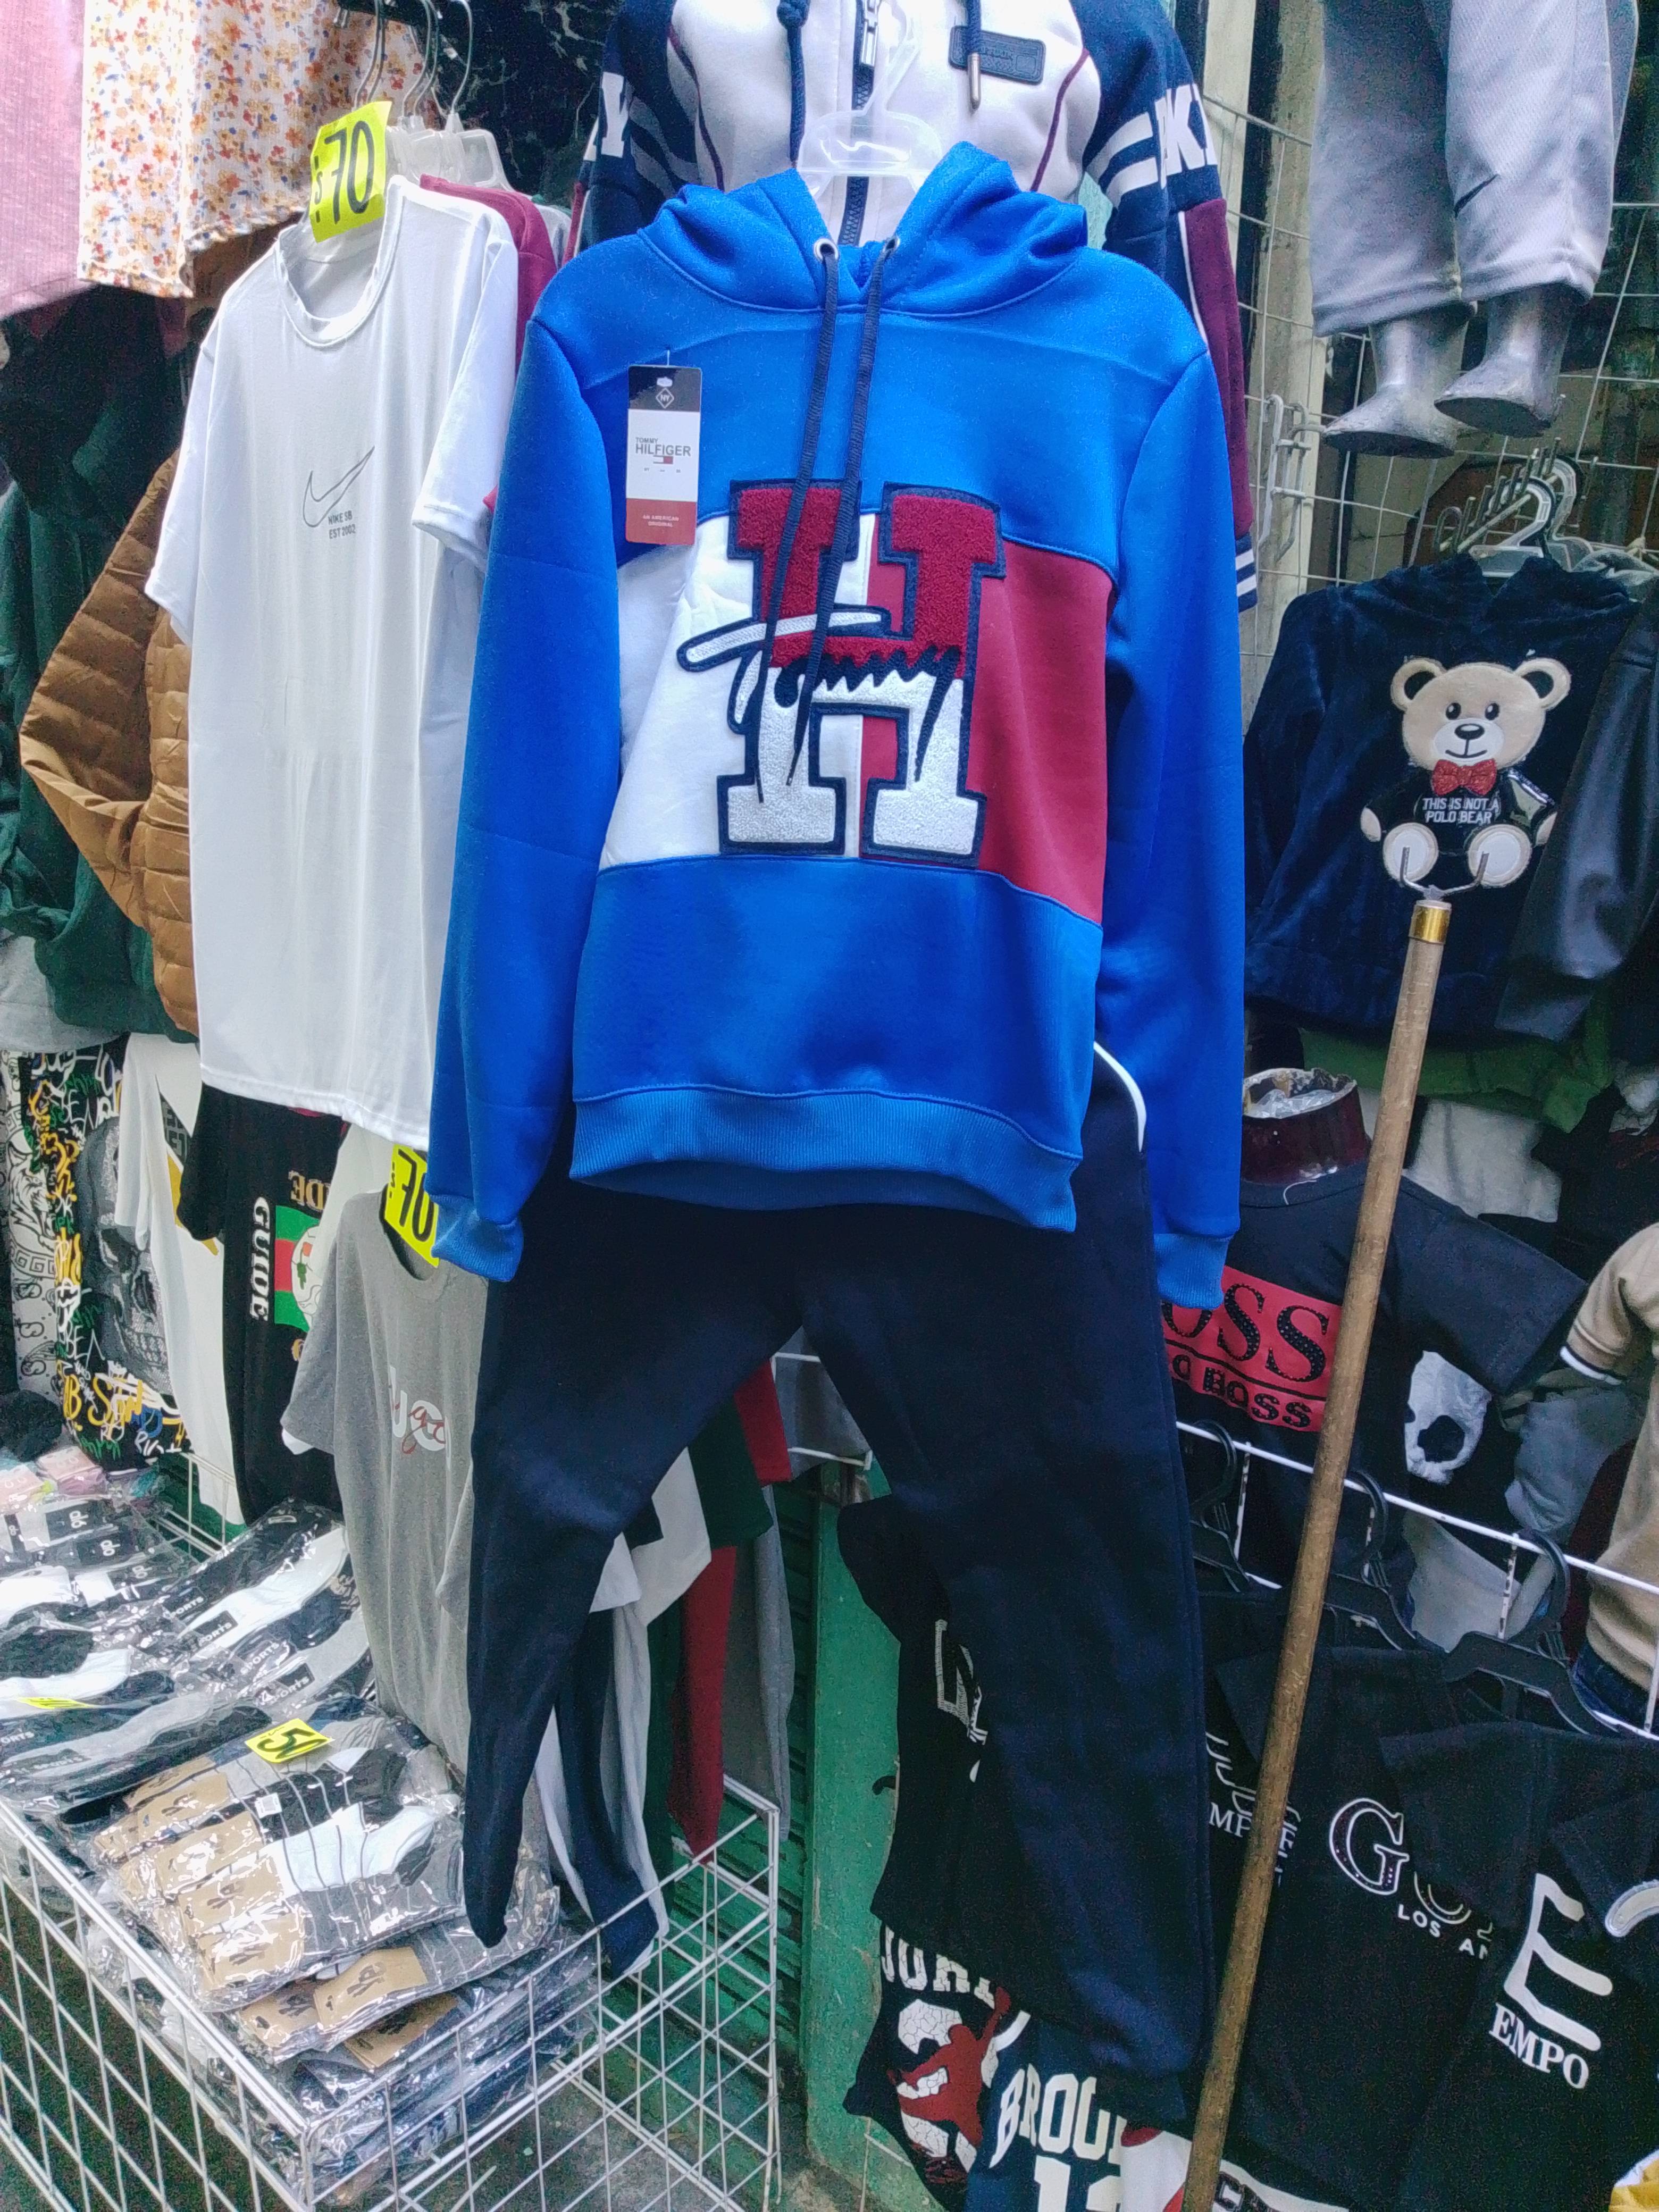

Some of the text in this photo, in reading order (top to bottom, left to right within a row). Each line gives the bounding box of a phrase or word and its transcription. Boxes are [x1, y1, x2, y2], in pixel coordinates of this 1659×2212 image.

[635, 443, 691, 457] HILFIGER
[328, 512, 343, 525] NIKE
[329, 523, 356, 539] EST 2002
[1422, 798, 1447, 810] THIS
[1448, 797, 1462, 810] IS
[1463, 798, 1488, 810] NOT
[1425, 811, 1493, 825] POLO BEAR
[250, 1196, 270, 1321] GUIDE
[1203, 1367, 1312, 1428] BOSS
[1398, 1904, 1442, 1938] LOS
